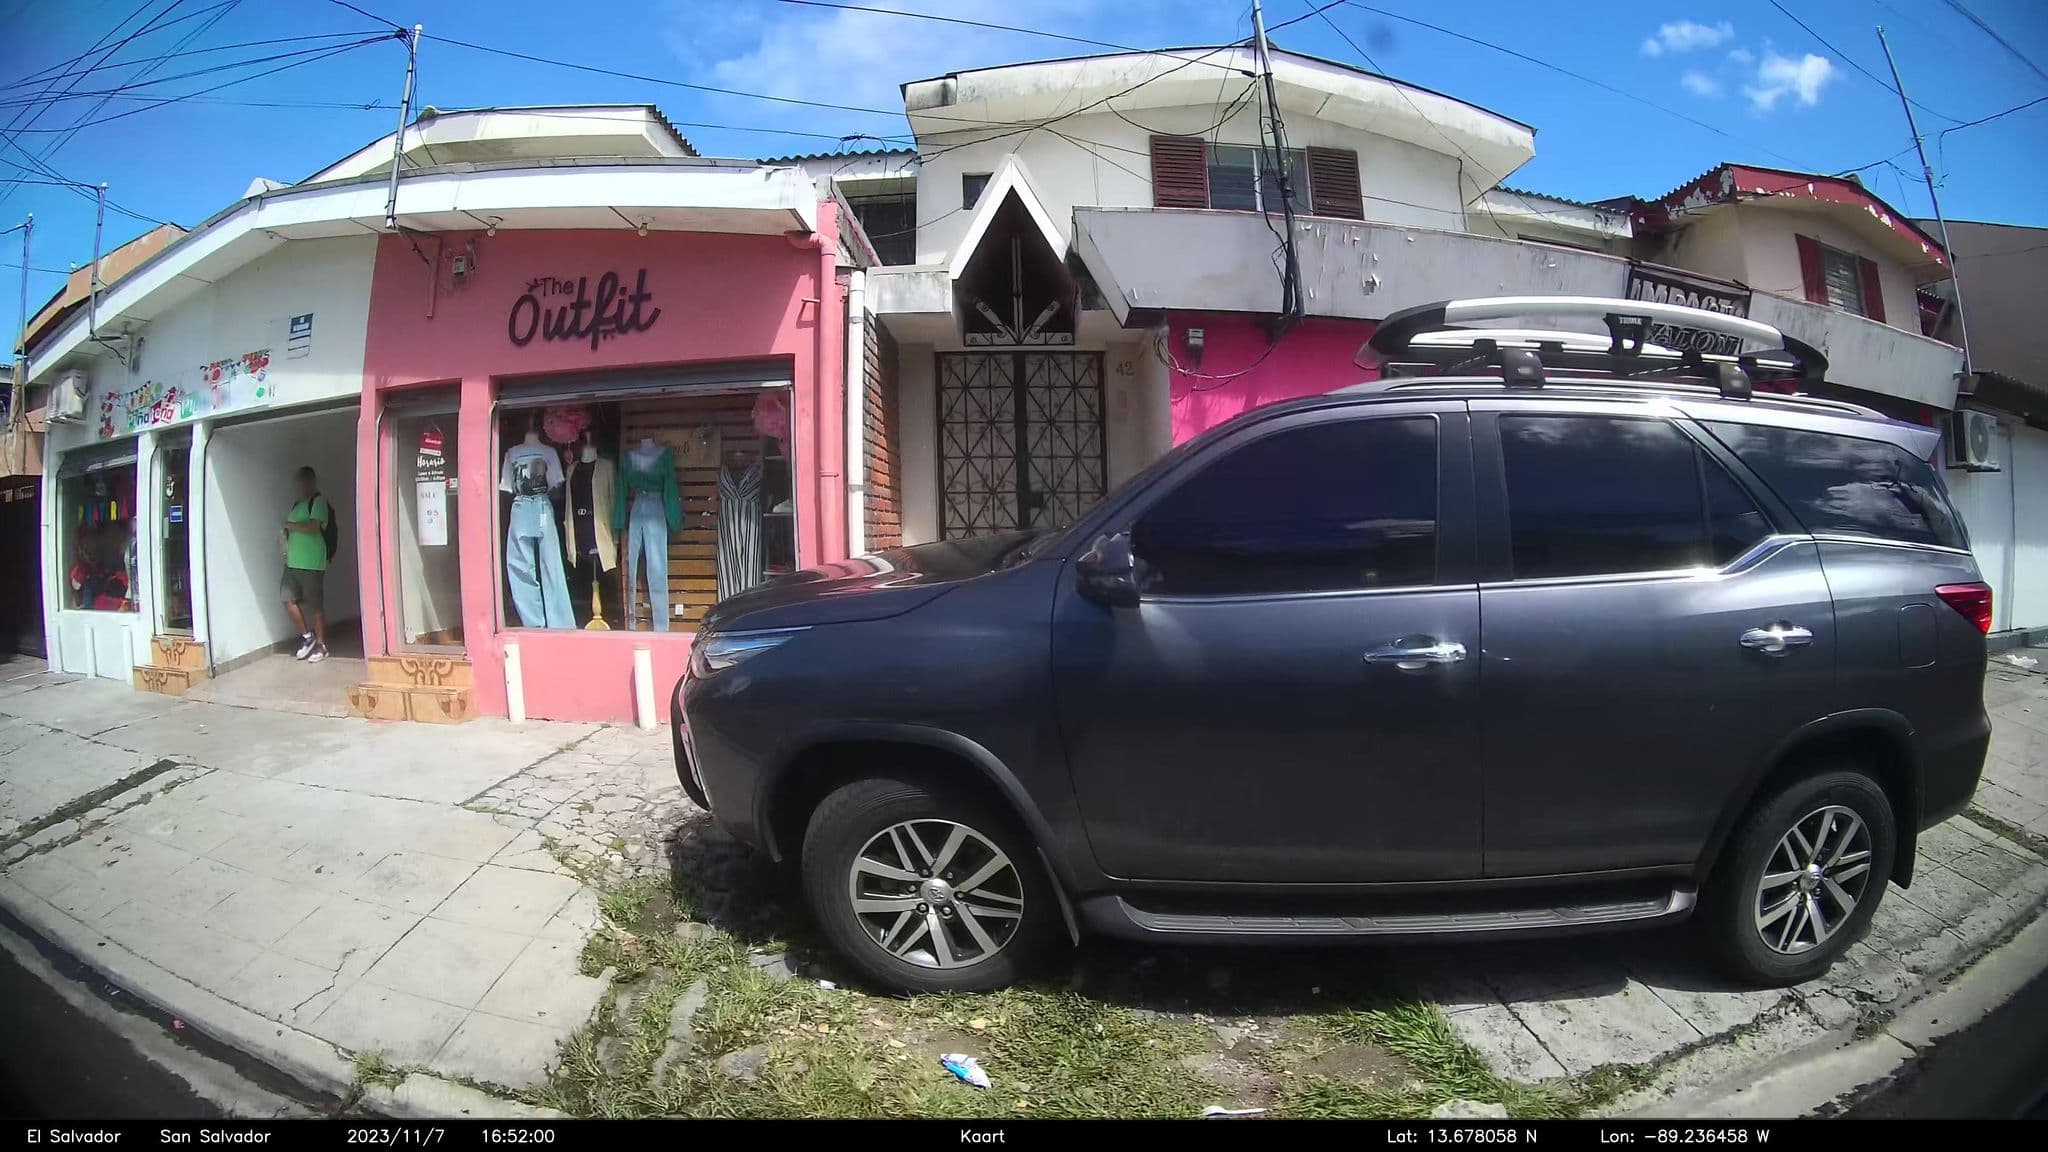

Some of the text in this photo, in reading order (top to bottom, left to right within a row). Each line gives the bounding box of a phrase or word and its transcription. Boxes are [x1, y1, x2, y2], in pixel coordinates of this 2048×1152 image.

[541, 277, 574, 296] The
[509, 269, 661, 351] Outfit
[1646, 323, 1741, 356] ALON
[1116, 360, 1136, 376] 42
